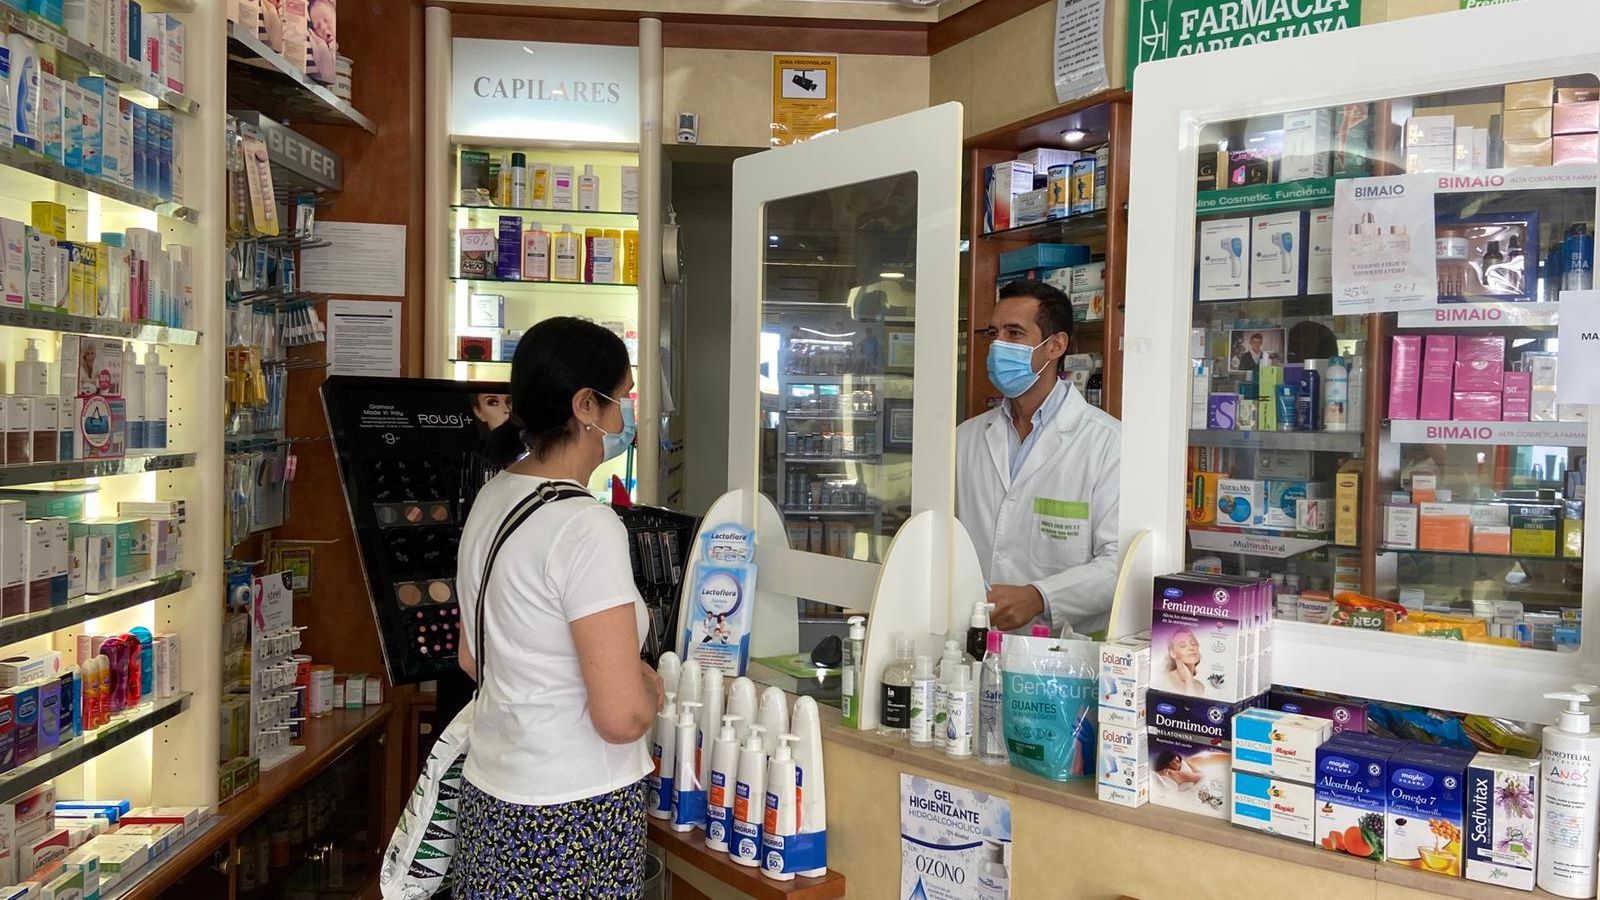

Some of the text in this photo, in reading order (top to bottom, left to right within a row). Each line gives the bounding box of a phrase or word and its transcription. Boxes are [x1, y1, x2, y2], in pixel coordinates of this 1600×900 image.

[1179, 0, 1350, 40] FARMACIA
[473, 75, 621, 104] CAPILARES
[270, 128, 336, 180] BETER
[1438, 175, 1504, 189] BIMAIO
[1219, 193, 1272, 205] Cosmetic.
[1275, 187, 1330, 199] Funciona.
[1355, 184, 1405, 198] BIMAIO
[466, 235, 489, 246] 50%
[1435, 308, 1501, 322] BIMAIO
[1427, 426, 1492, 440] BIMAIO
[711, 533, 747, 541] Lactoflora
[1233, 540, 1286, 553] Multinatural
[702, 588, 737, 597] Lactoflora
[1162, 599, 1230, 618] Feminpausia
[1353, 616, 1383, 628] NEO
[1102, 651, 1133, 667] Golamir
[1012, 700, 1057, 713] GUANTES
[1155, 713, 1223, 737] Dormimoon
[1102, 730, 1133, 746] Golamir
[1275, 747, 1296, 756] Rapid
[1328, 760, 1350, 769] mayla
[1401, 772, 1424, 782] mayla
[1320, 776, 1364, 794] Alcachofa
[934, 789, 954, 804] GEL
[1392, 787, 1437, 805] Omega 7
[909, 795, 980, 824] HIGIENIZANTE
[1274, 804, 1294, 813] Rapid
[1472, 777, 1489, 843] Sedivitax
[916, 854, 965, 885] OZONO
